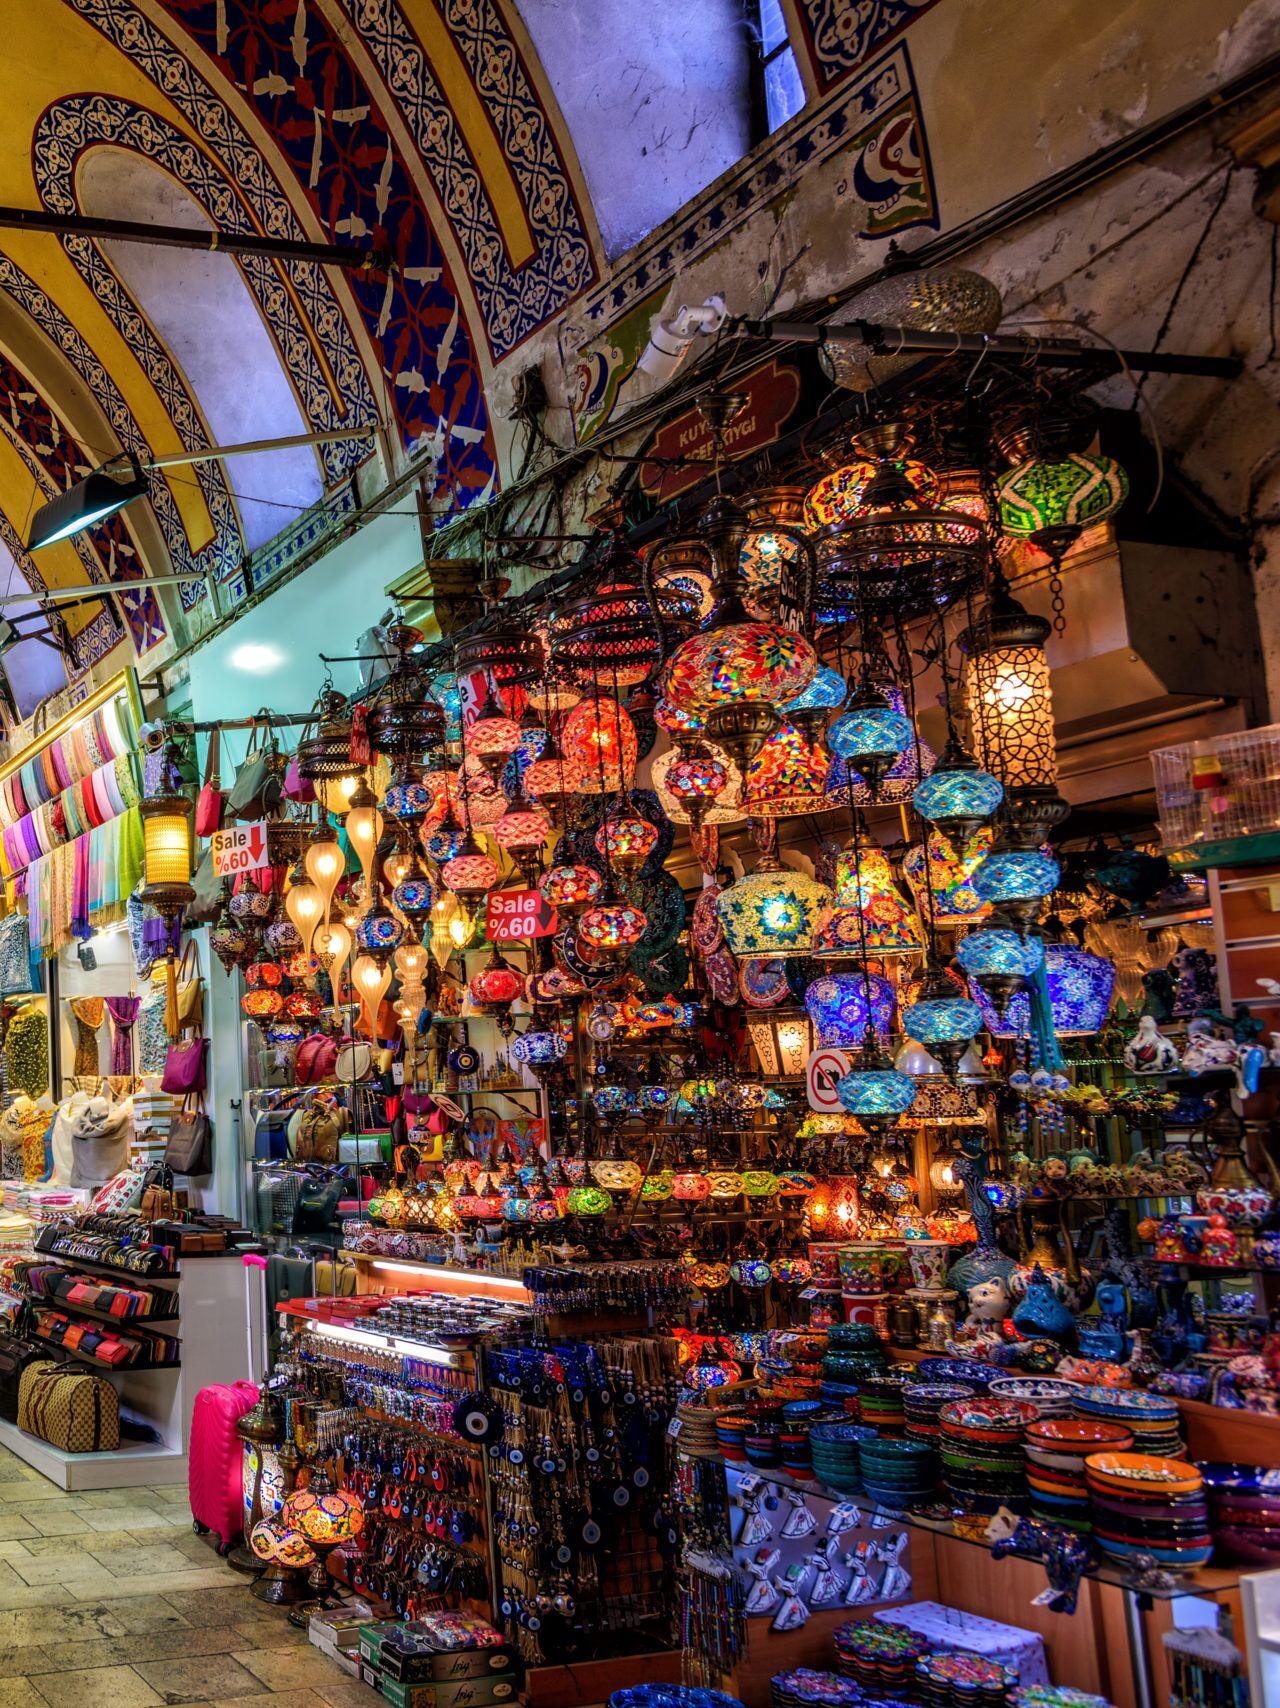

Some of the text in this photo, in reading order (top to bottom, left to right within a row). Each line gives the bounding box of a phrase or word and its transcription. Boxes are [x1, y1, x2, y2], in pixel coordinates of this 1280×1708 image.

[215, 831, 247, 851] Sale
[215, 850, 249, 874] %60
[490, 894, 536, 914] Sale
[489, 916, 536, 938] %60
